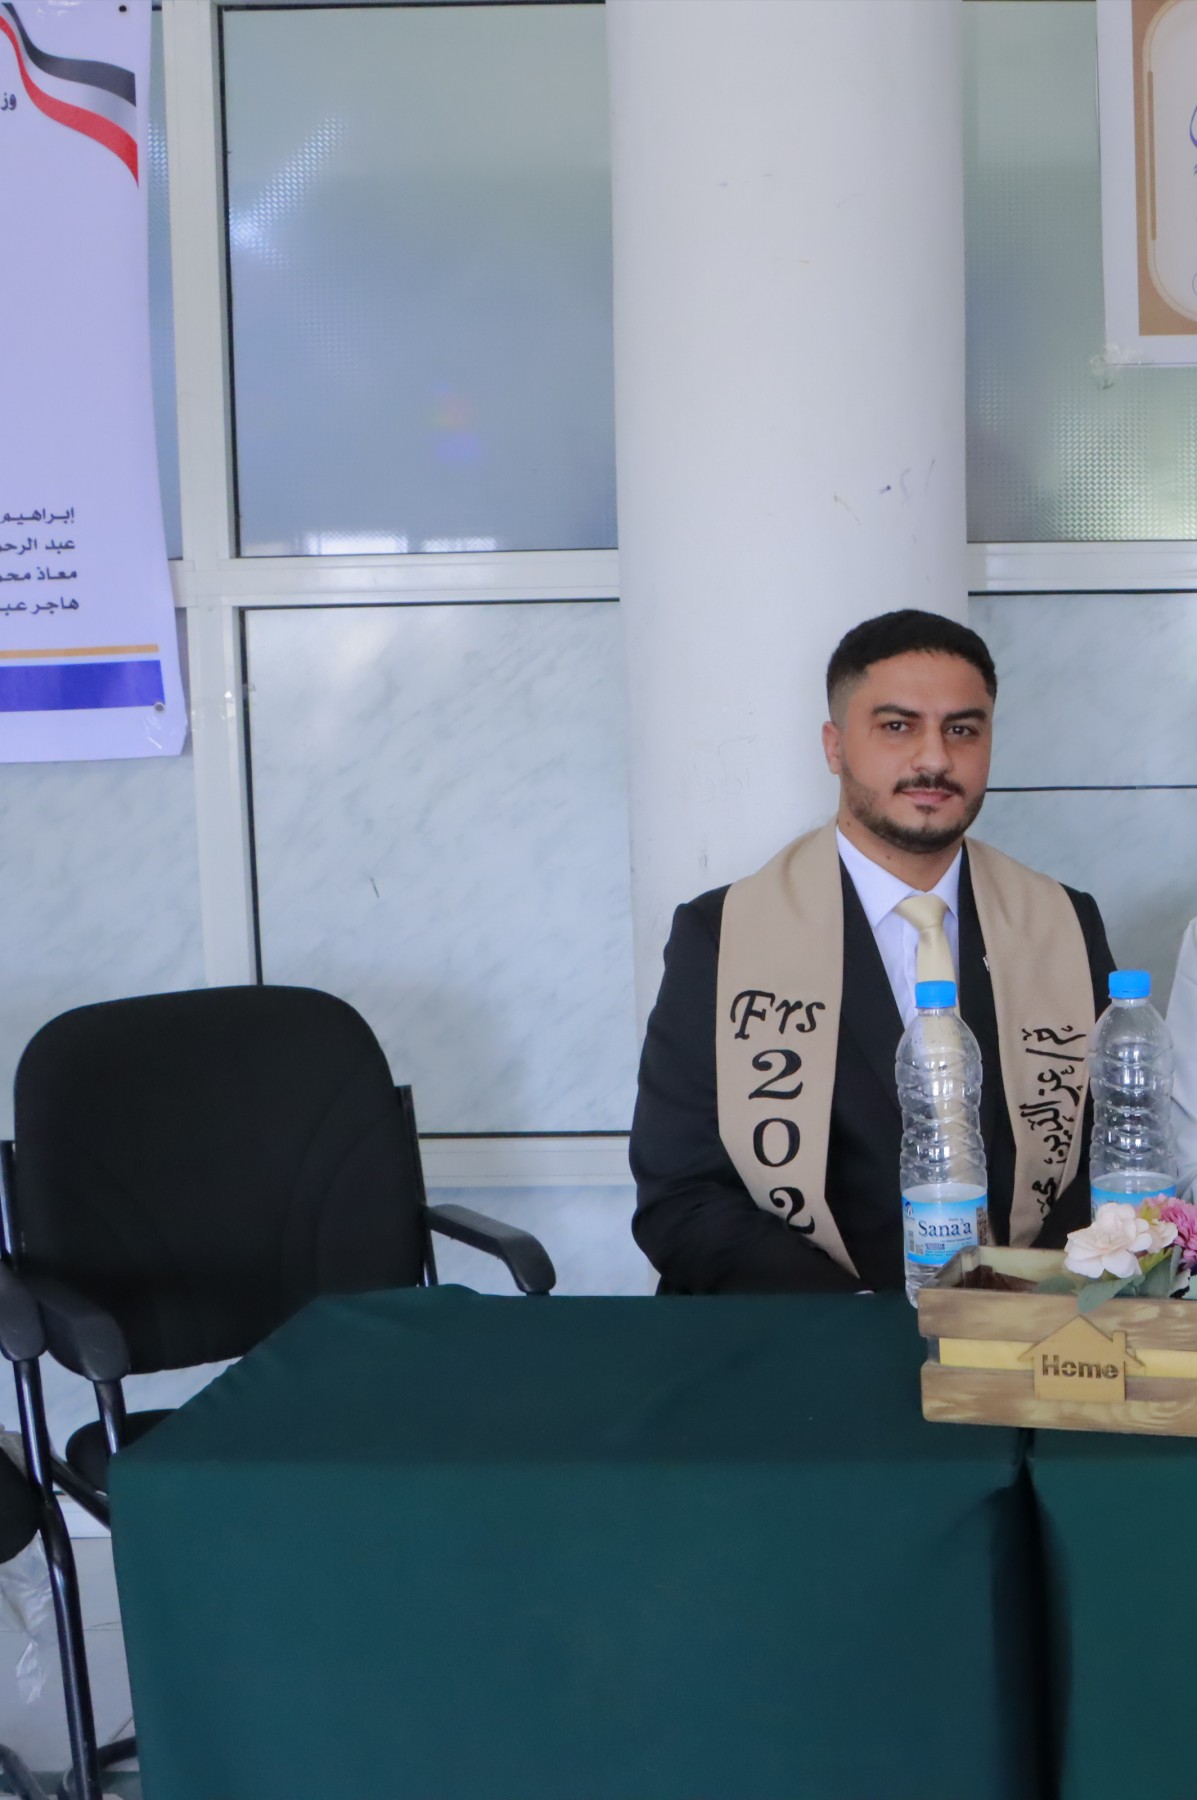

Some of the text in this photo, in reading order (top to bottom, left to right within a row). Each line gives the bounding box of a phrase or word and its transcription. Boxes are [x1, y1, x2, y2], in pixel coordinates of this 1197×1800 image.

[0, 537, 76, 555] عبد الرح
[36, 566, 77, 581] معاذ
[30, 596, 79, 615] هاجر
[730, 990, 826, 1040] Frs
[918, 1218, 972, 1237] Sana'a
[1042, 1354, 1119, 1379] Home
